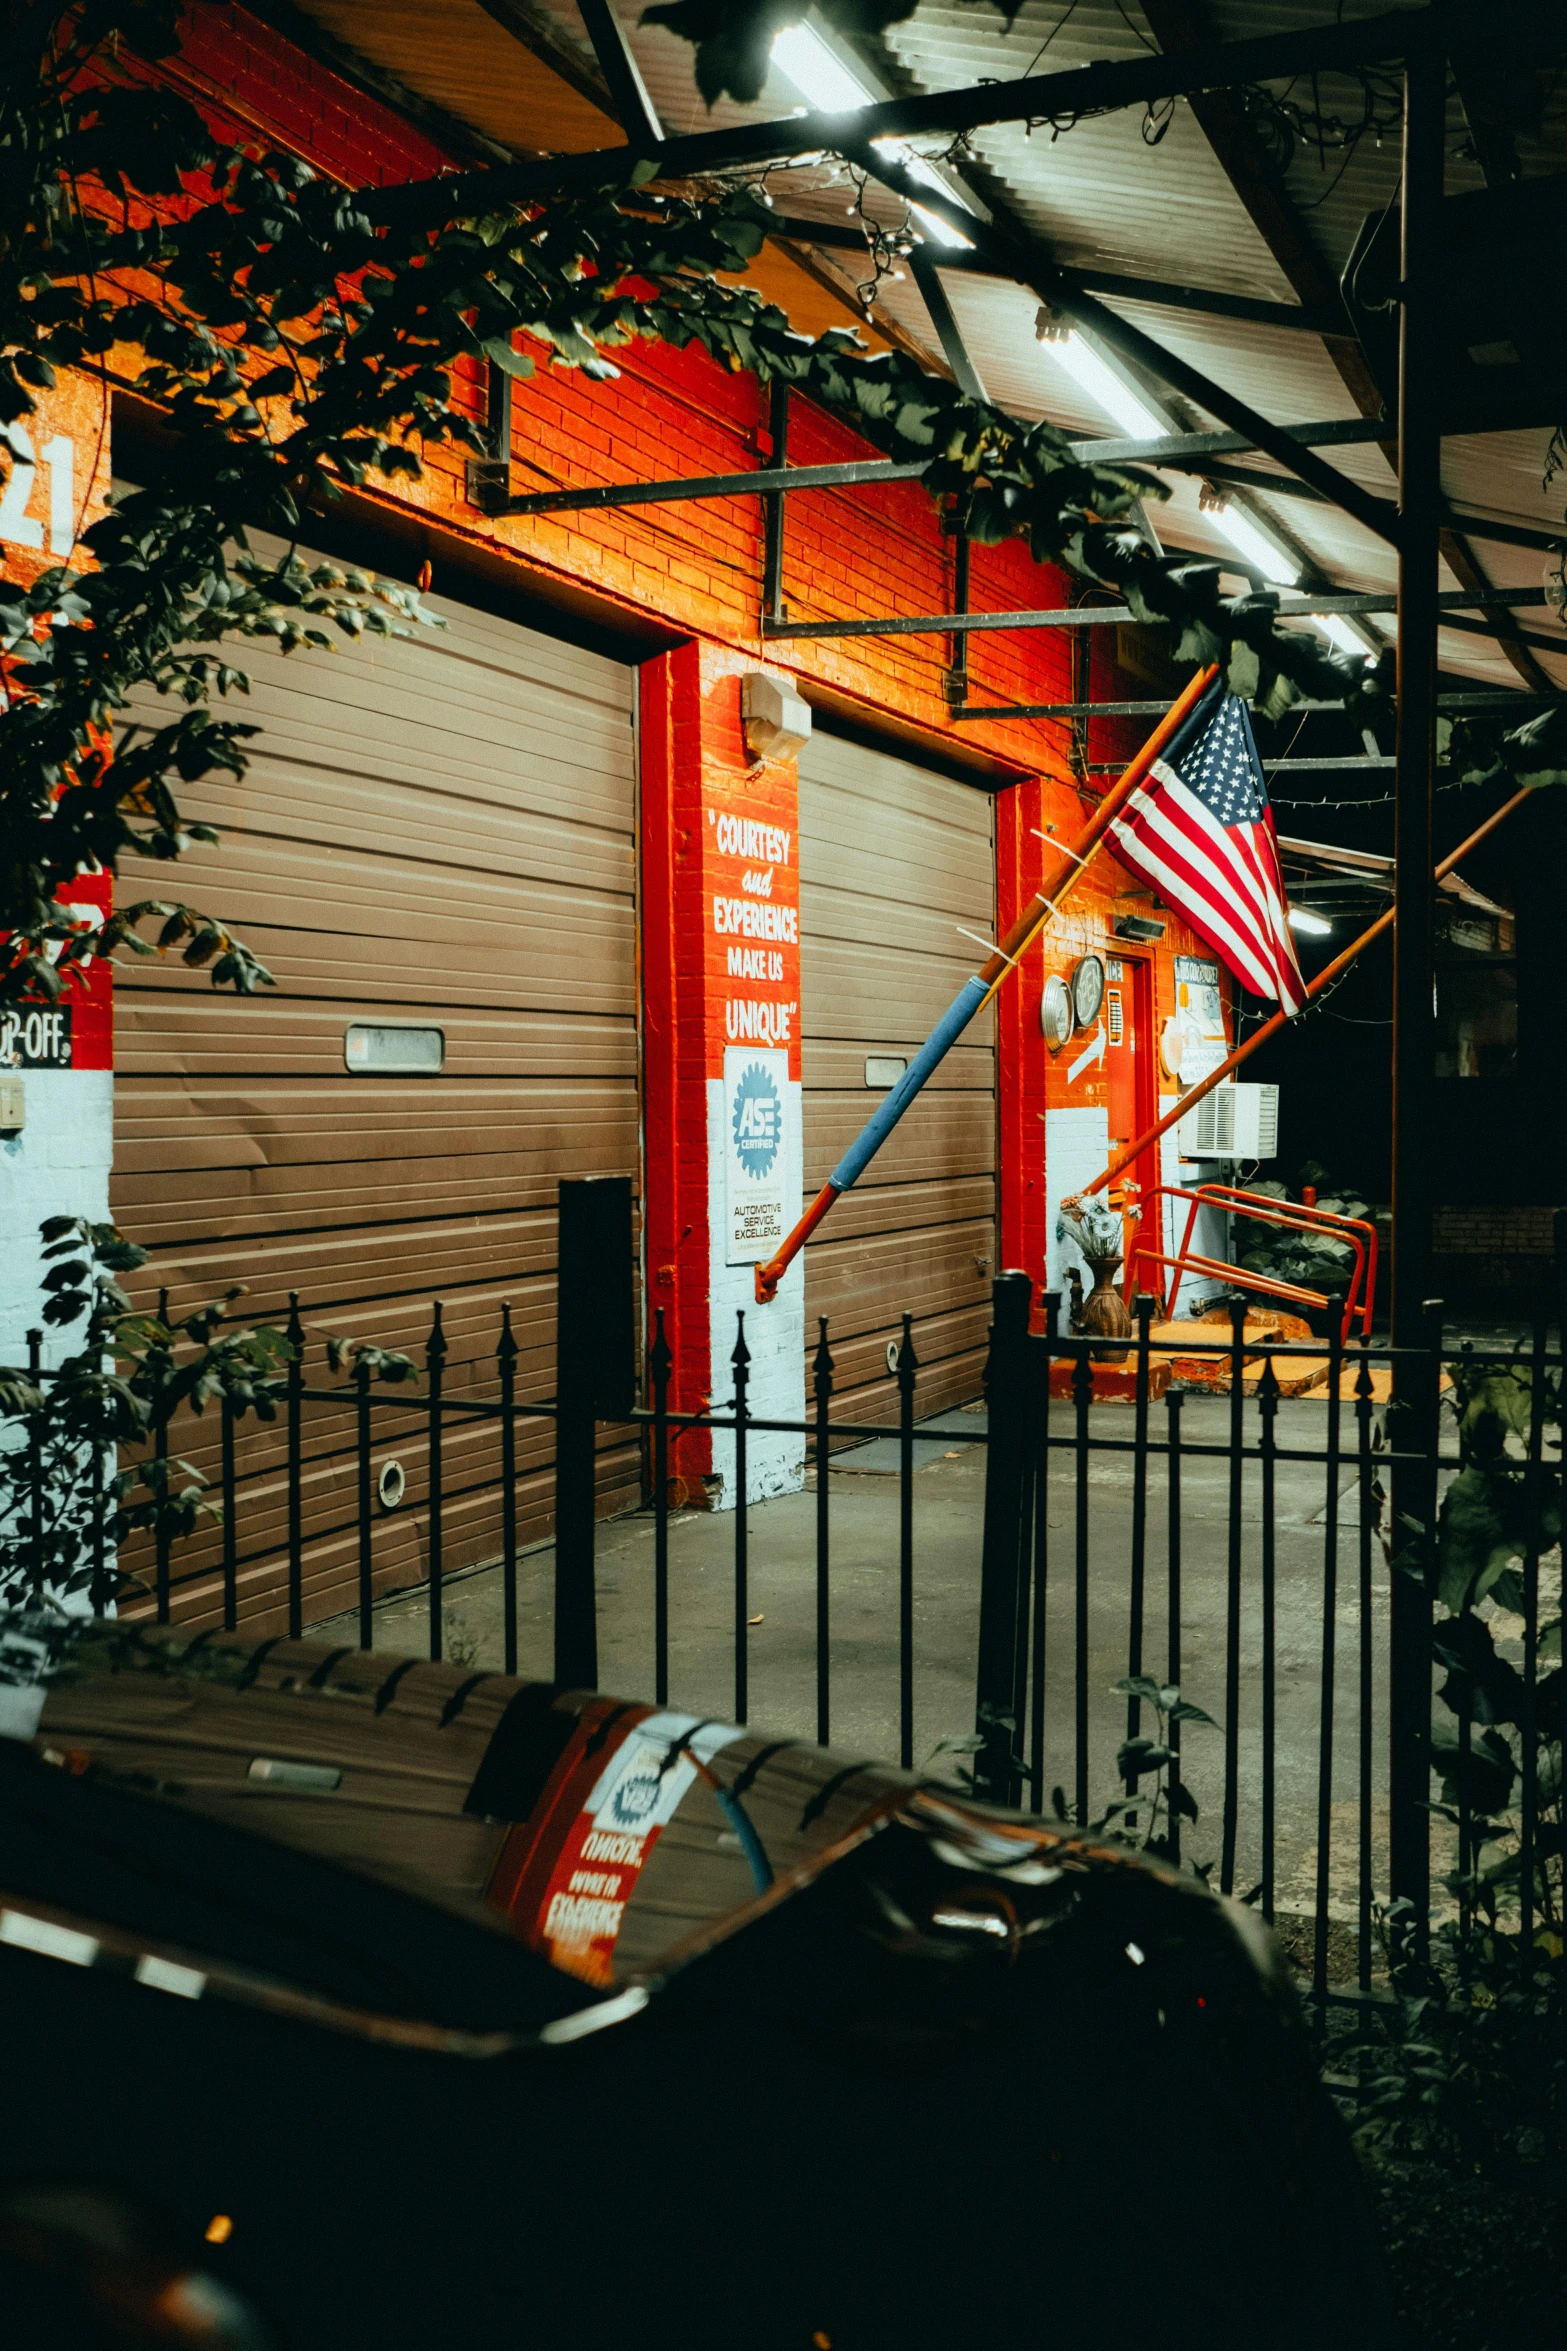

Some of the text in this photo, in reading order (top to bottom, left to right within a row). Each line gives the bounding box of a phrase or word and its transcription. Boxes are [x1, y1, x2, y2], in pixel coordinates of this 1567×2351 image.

[708, 808, 791, 866] "COURTESY
[741, 867, 774, 898] and
[713, 896, 798, 944] EXPERIENCE
[727, 946, 784, 982] MAKE US
[725, 999, 797, 1047] UNIQUE"
[738, 1097, 775, 1137] ASE
[741, 1138, 774, 1149] CERTIFIED
[734, 1203, 782, 1216] AUTOMOTIVE
[744, 1215, 775, 1228] SERVICE
[735, 1226, 782, 1240] EXCELLENCE
